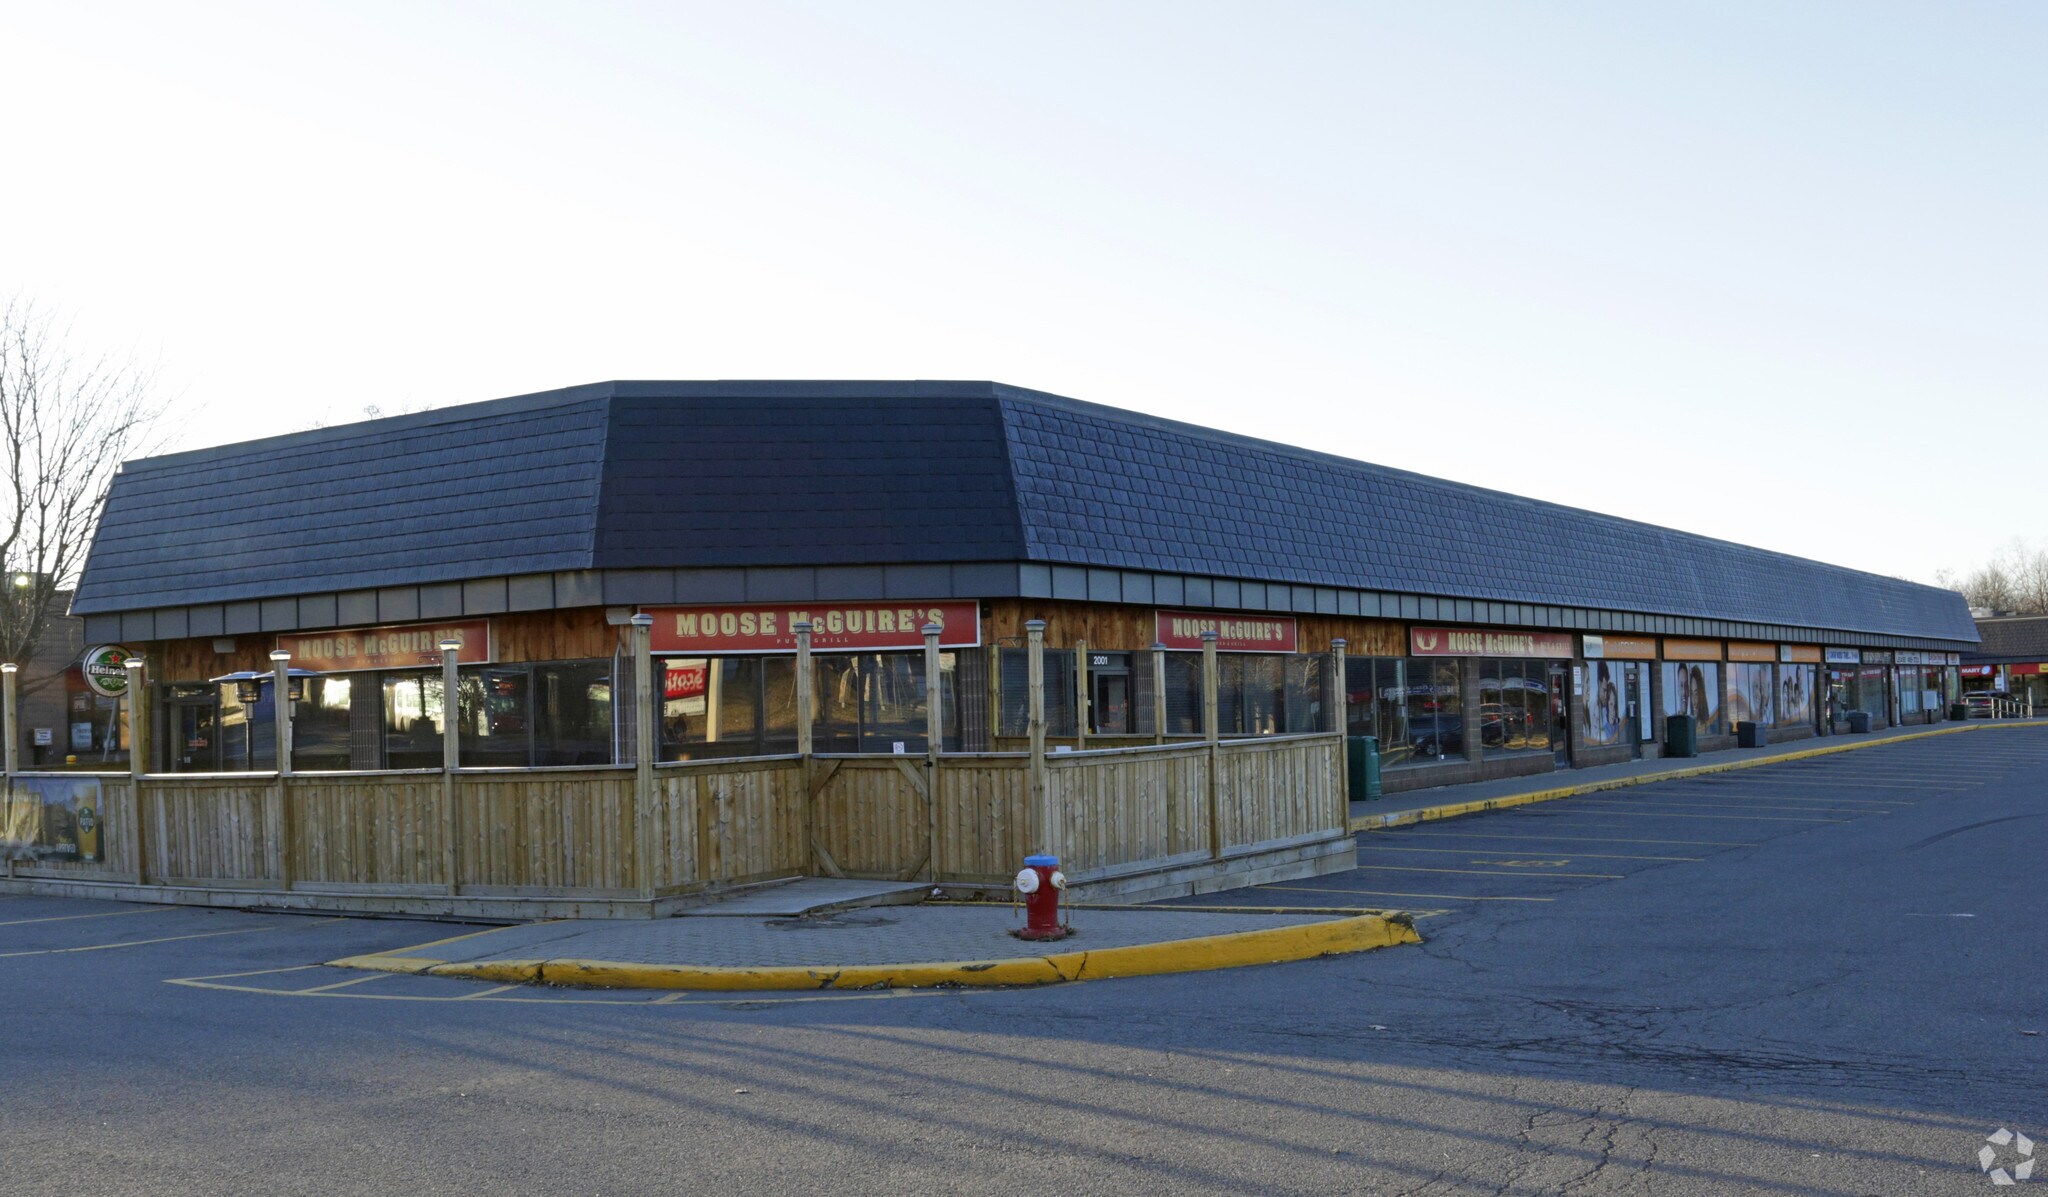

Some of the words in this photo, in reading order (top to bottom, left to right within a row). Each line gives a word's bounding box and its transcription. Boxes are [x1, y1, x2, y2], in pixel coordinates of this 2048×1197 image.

[675, 612, 777, 638] MOOSE
[1172, 617, 1217, 639] MOOSE
[1220, 620, 1283, 641] McGUIRE'S
[298, 636, 358, 660] MOOSE
[364, 628, 465, 656] McGUIRE'S
[1448, 632, 1483, 654] MOOSE
[1485, 633, 1534, 655] McGUIRE'S
[90, 665, 128, 676] Heinek
[1093, 655, 1108, 665] 2001
